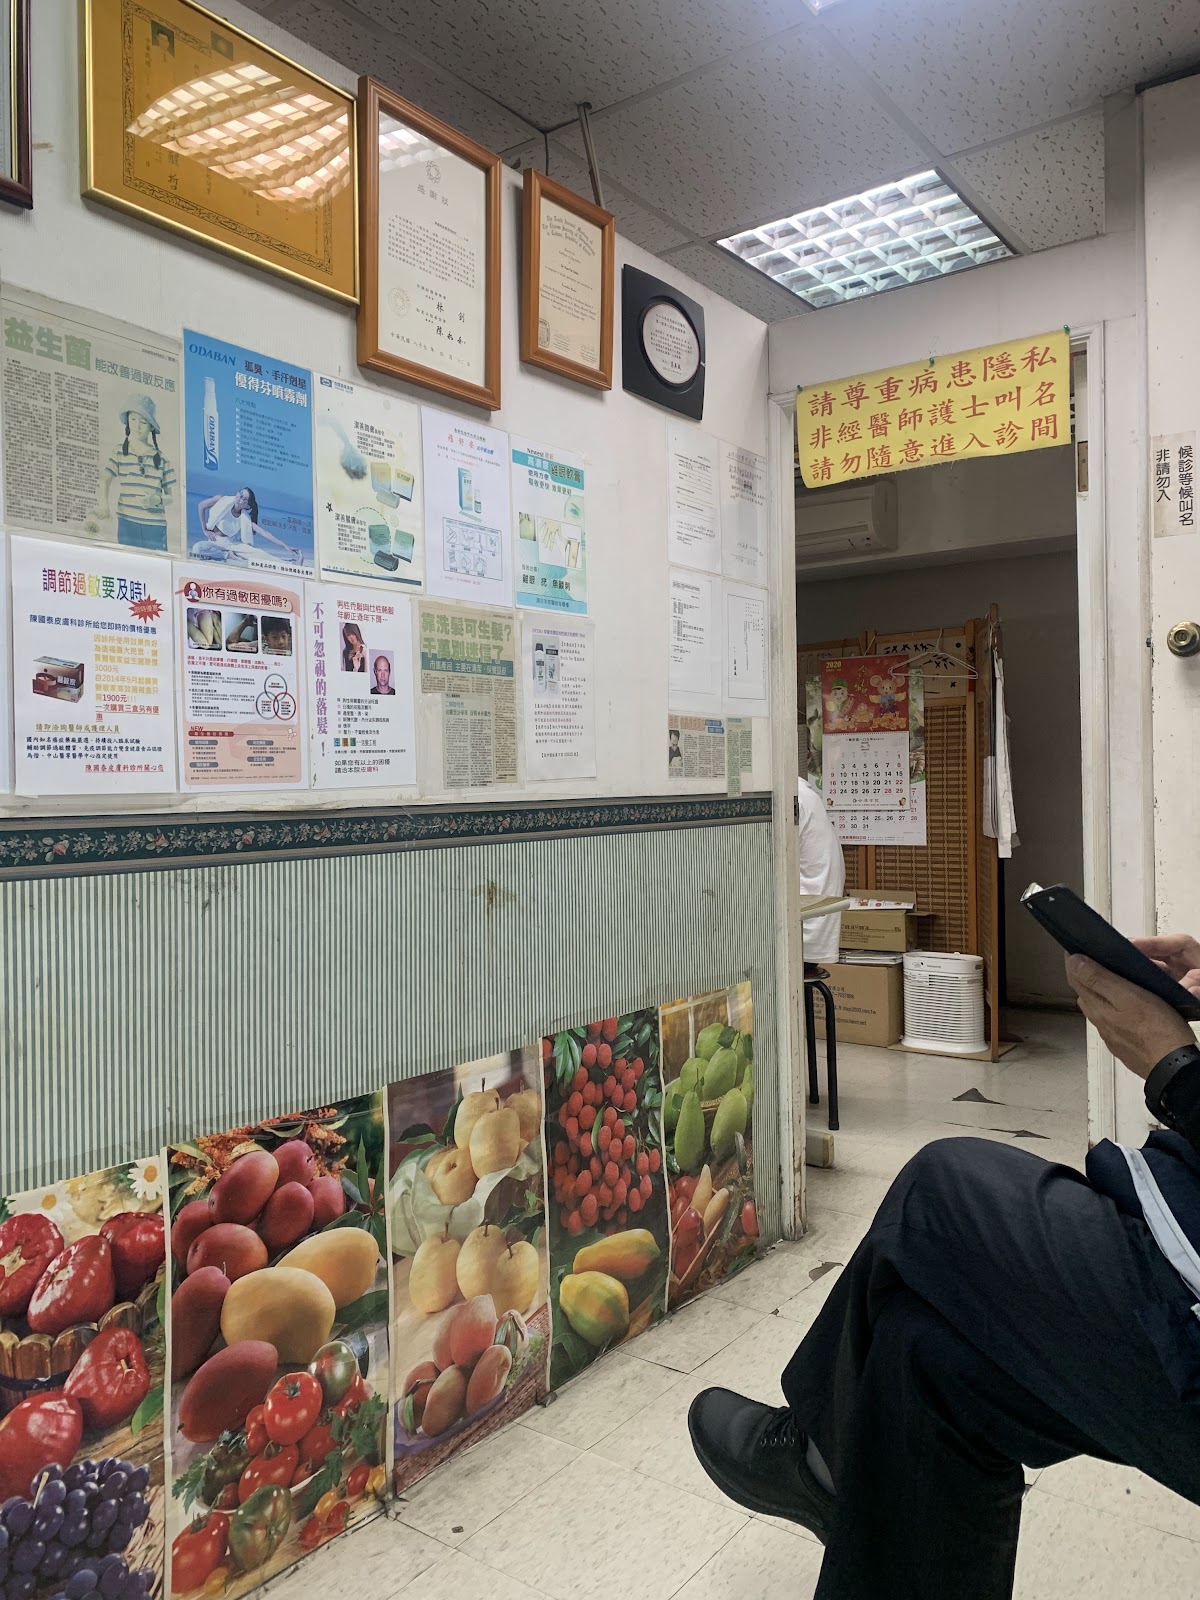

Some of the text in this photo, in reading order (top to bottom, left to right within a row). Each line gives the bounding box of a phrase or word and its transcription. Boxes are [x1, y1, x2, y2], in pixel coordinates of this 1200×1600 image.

[4, 316, 176, 392] 益生菌 能改善過敏反應
[189, 343, 237, 366] ODABAN
[235, 372, 307, 408] 優得芬噴霧劑
[808, 346, 1057, 417] 請尊重病患隱私
[810, 381, 1056, 450] 非經醫師護士叫名
[208, 415, 218, 455] ODABAN
[809, 414, 1058, 481] 請勿隨意進入診間
[1156, 449, 1171, 503] 非請勿入
[1178, 445, 1194, 526] 候診等候叫名
[42, 568, 148, 603] 調節過敏要及時!
[202, 586, 288, 609] 你有過敏困擾嗎?
[30, 614, 157, 635] 陳國泰皮膚科診所給您即時的價格優惠
[421, 612, 512, 642] 靠洗髮可生髮?
[422, 637, 504, 664] 千萬別迷信了
[95, 664, 124, 673] 3000元
[312, 602, 328, 757] 不可忽視的落髮!
[96, 704, 160, 715] 一次購買三盒另有優
[86, 764, 164, 772] 陳國泰皮膚科診所關心您
